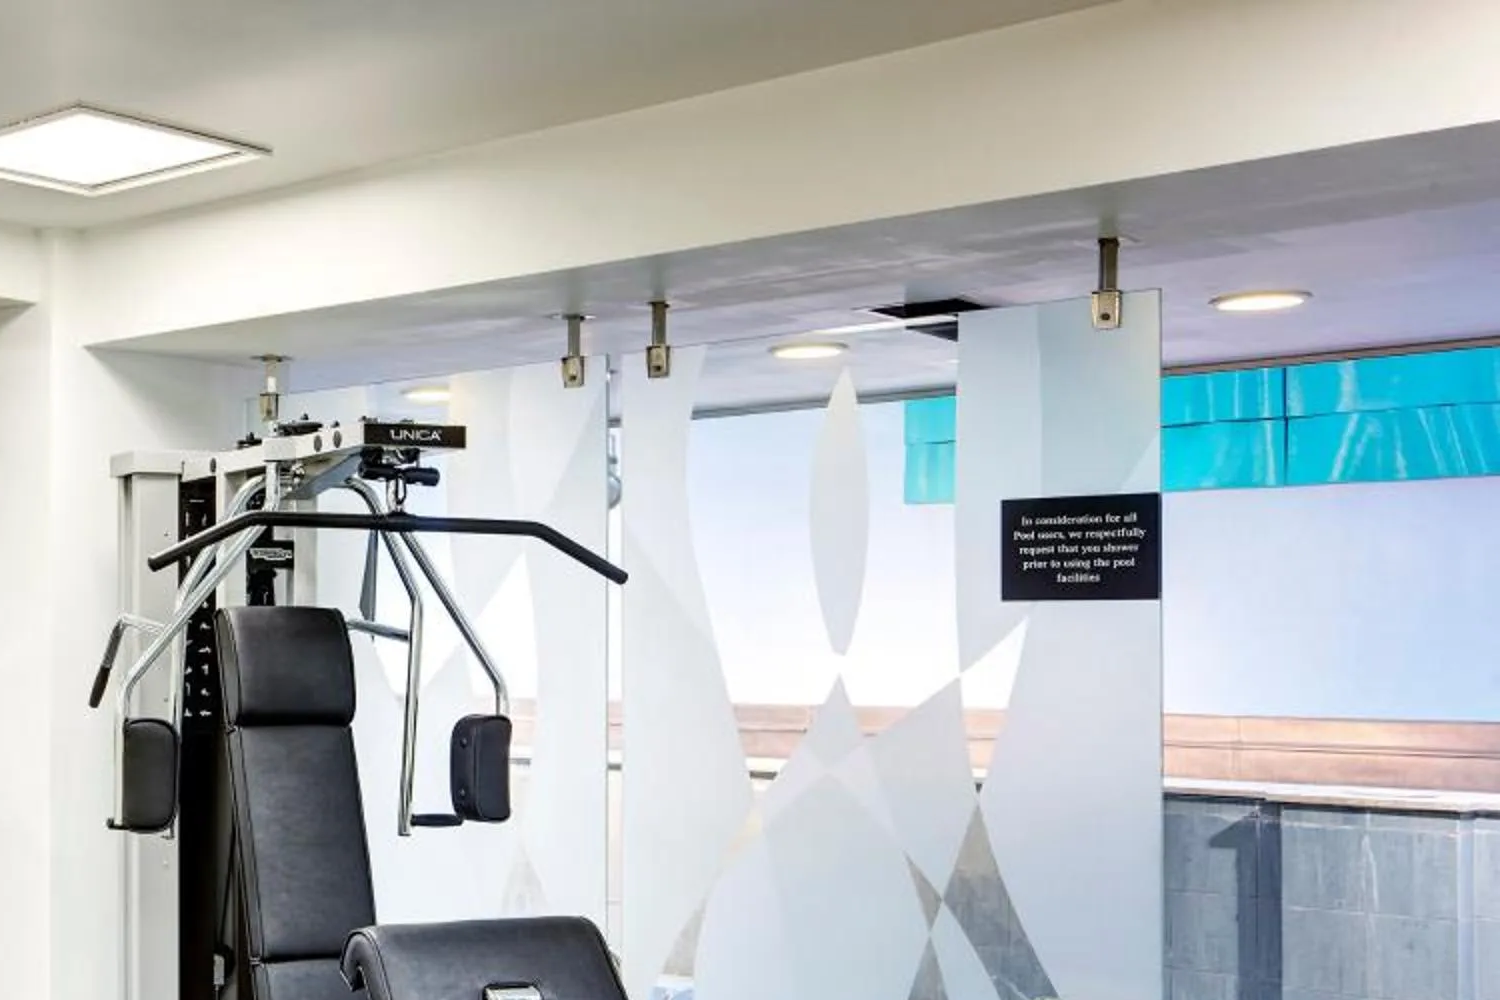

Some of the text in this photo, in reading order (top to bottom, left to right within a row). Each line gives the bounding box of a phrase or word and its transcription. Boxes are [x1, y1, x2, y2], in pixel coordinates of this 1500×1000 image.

[389, 428, 442, 441] UNICA
[1035, 514, 1103, 525] consideration
[1105, 512, 1121, 523] for
[1123, 511, 1137, 523] all
[1013, 530, 1035, 540] Pool
[1067, 531, 1083, 539] we
[1085, 527, 1147, 540] respectfully
[1019, 542, 1139, 556] request that you shower
[1023, 556, 1135, 571] prior to using the pool
[1056, 572, 1101, 583] facilities
